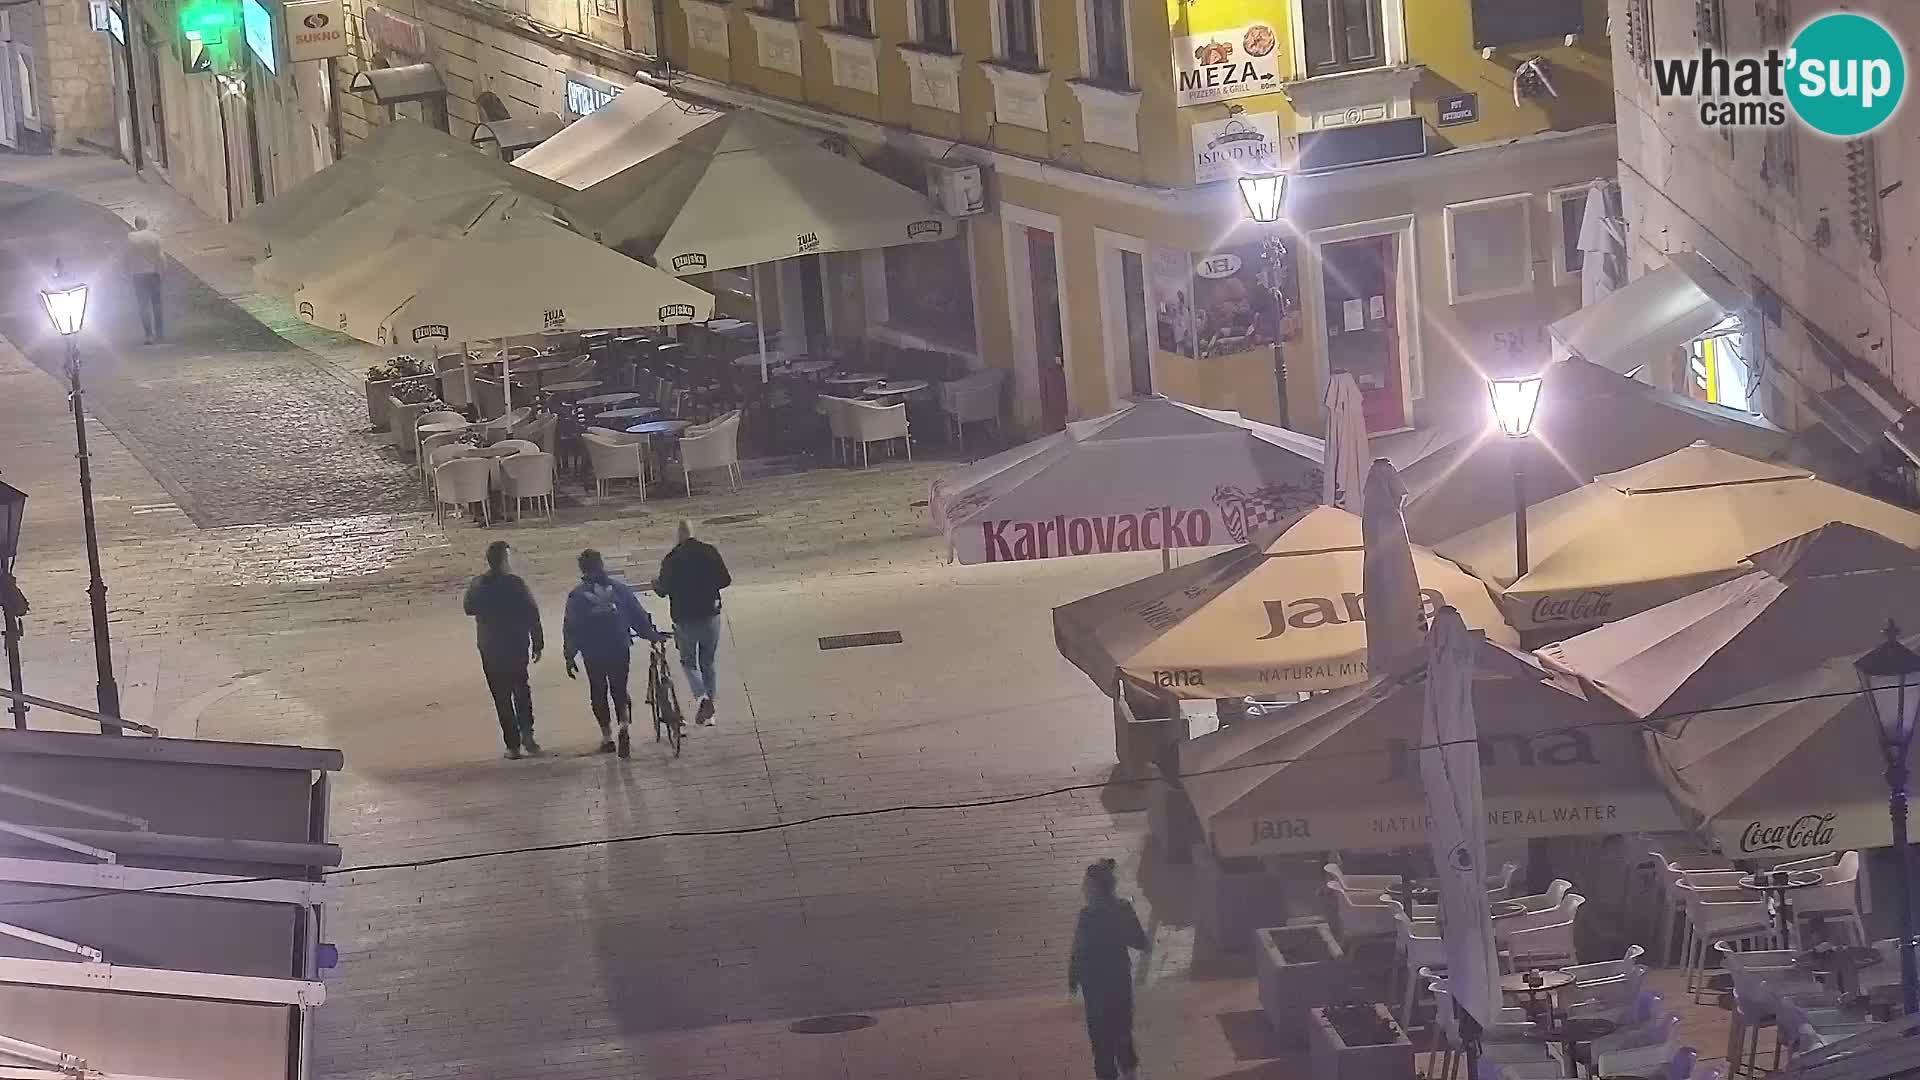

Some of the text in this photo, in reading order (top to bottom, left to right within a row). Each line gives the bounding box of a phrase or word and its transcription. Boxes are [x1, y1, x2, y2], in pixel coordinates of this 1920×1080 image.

[296, 31, 340, 45] SUKNO
[1180, 61, 1258, 91] MEZA
[1189, 83, 1251, 99] PIZZERIA & GRILL
[1199, 147, 1243, 165] ISPOD
[983, 506, 1211, 562] Karlovačko
[1258, 661, 1369, 681] NATURAL MIN
[1552, 804, 1617, 822] WATER
[1740, 812, 1837, 852] Coca-Cola
